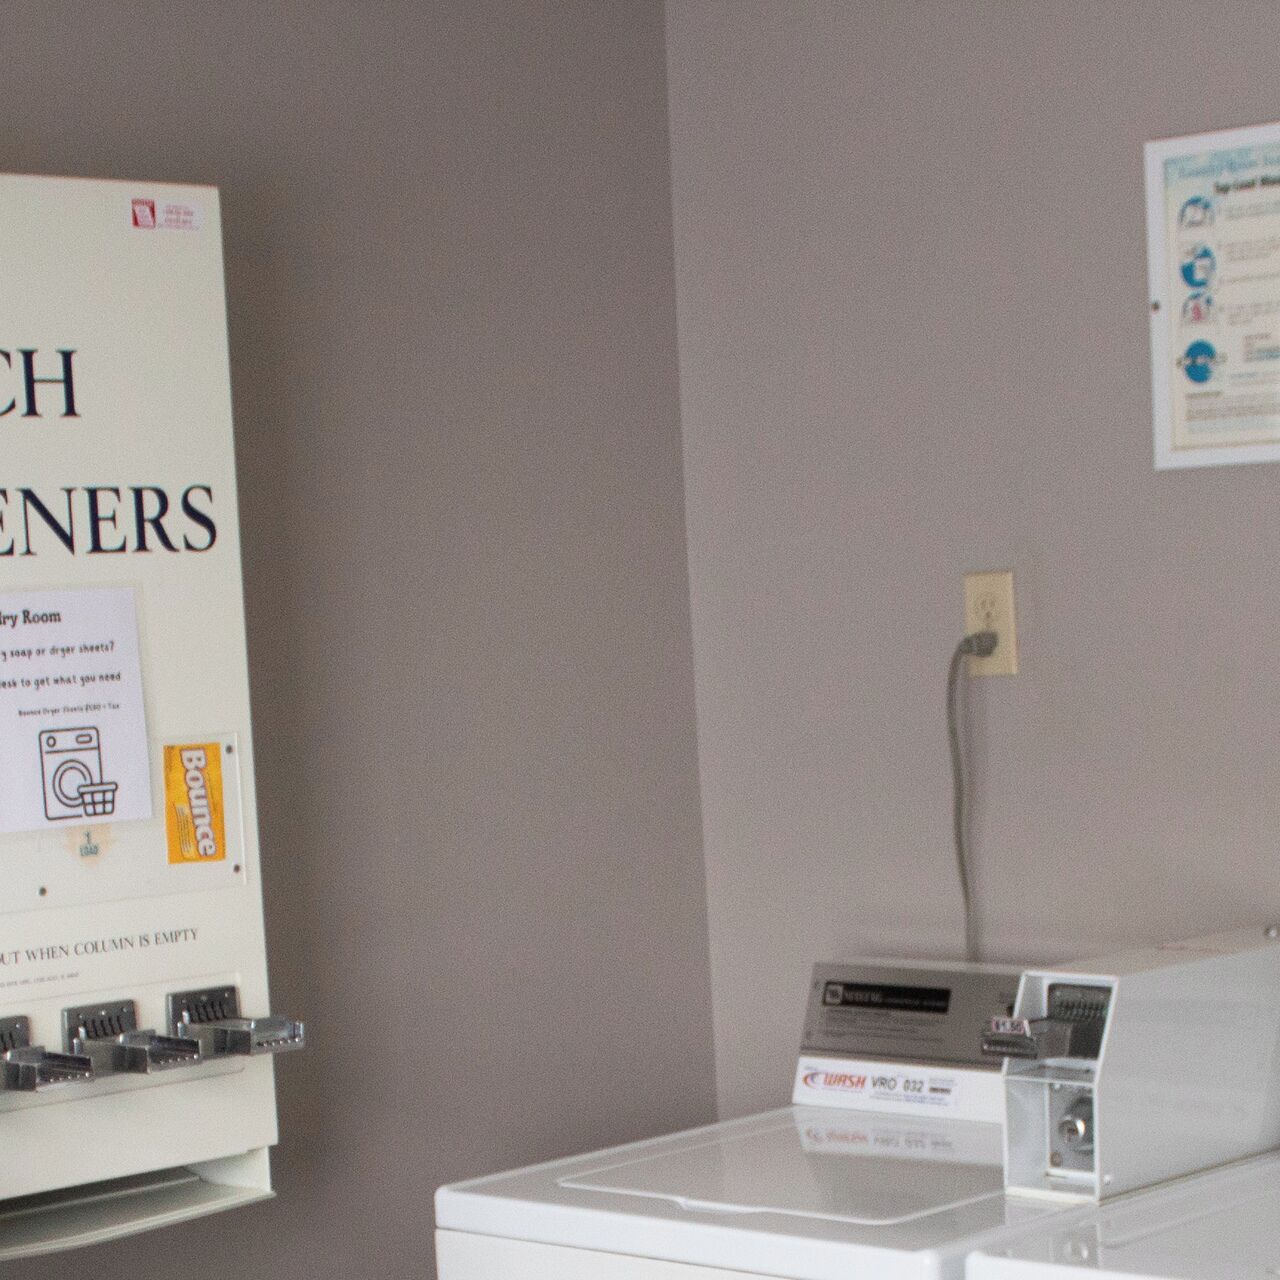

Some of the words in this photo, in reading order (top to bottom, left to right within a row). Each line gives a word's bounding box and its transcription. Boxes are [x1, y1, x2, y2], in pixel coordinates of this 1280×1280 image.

[22, 609, 62, 624] Room
[10, 648, 33, 662] soap
[35, 648, 46, 658] or
[49, 643, 76, 660] dryer
[78, 641, 115, 655] sheets?
[21, 676, 32, 688] to
[34, 674, 51, 690] get
[53, 673, 78, 686] what
[79, 674, 97, 687] you
[99, 670, 122, 683] need
[179, 746, 217, 857] Bounce
[78, 843, 100, 858] LOAD
[24, 942, 71, 965] WHEN
[73, 934, 136, 958] COLUMN
[138, 932, 151, 950] IS
[154, 926, 199, 948] EMPTY
[822, 1072, 867, 1089] WASH
[871, 1077, 898, 1091] VRO
